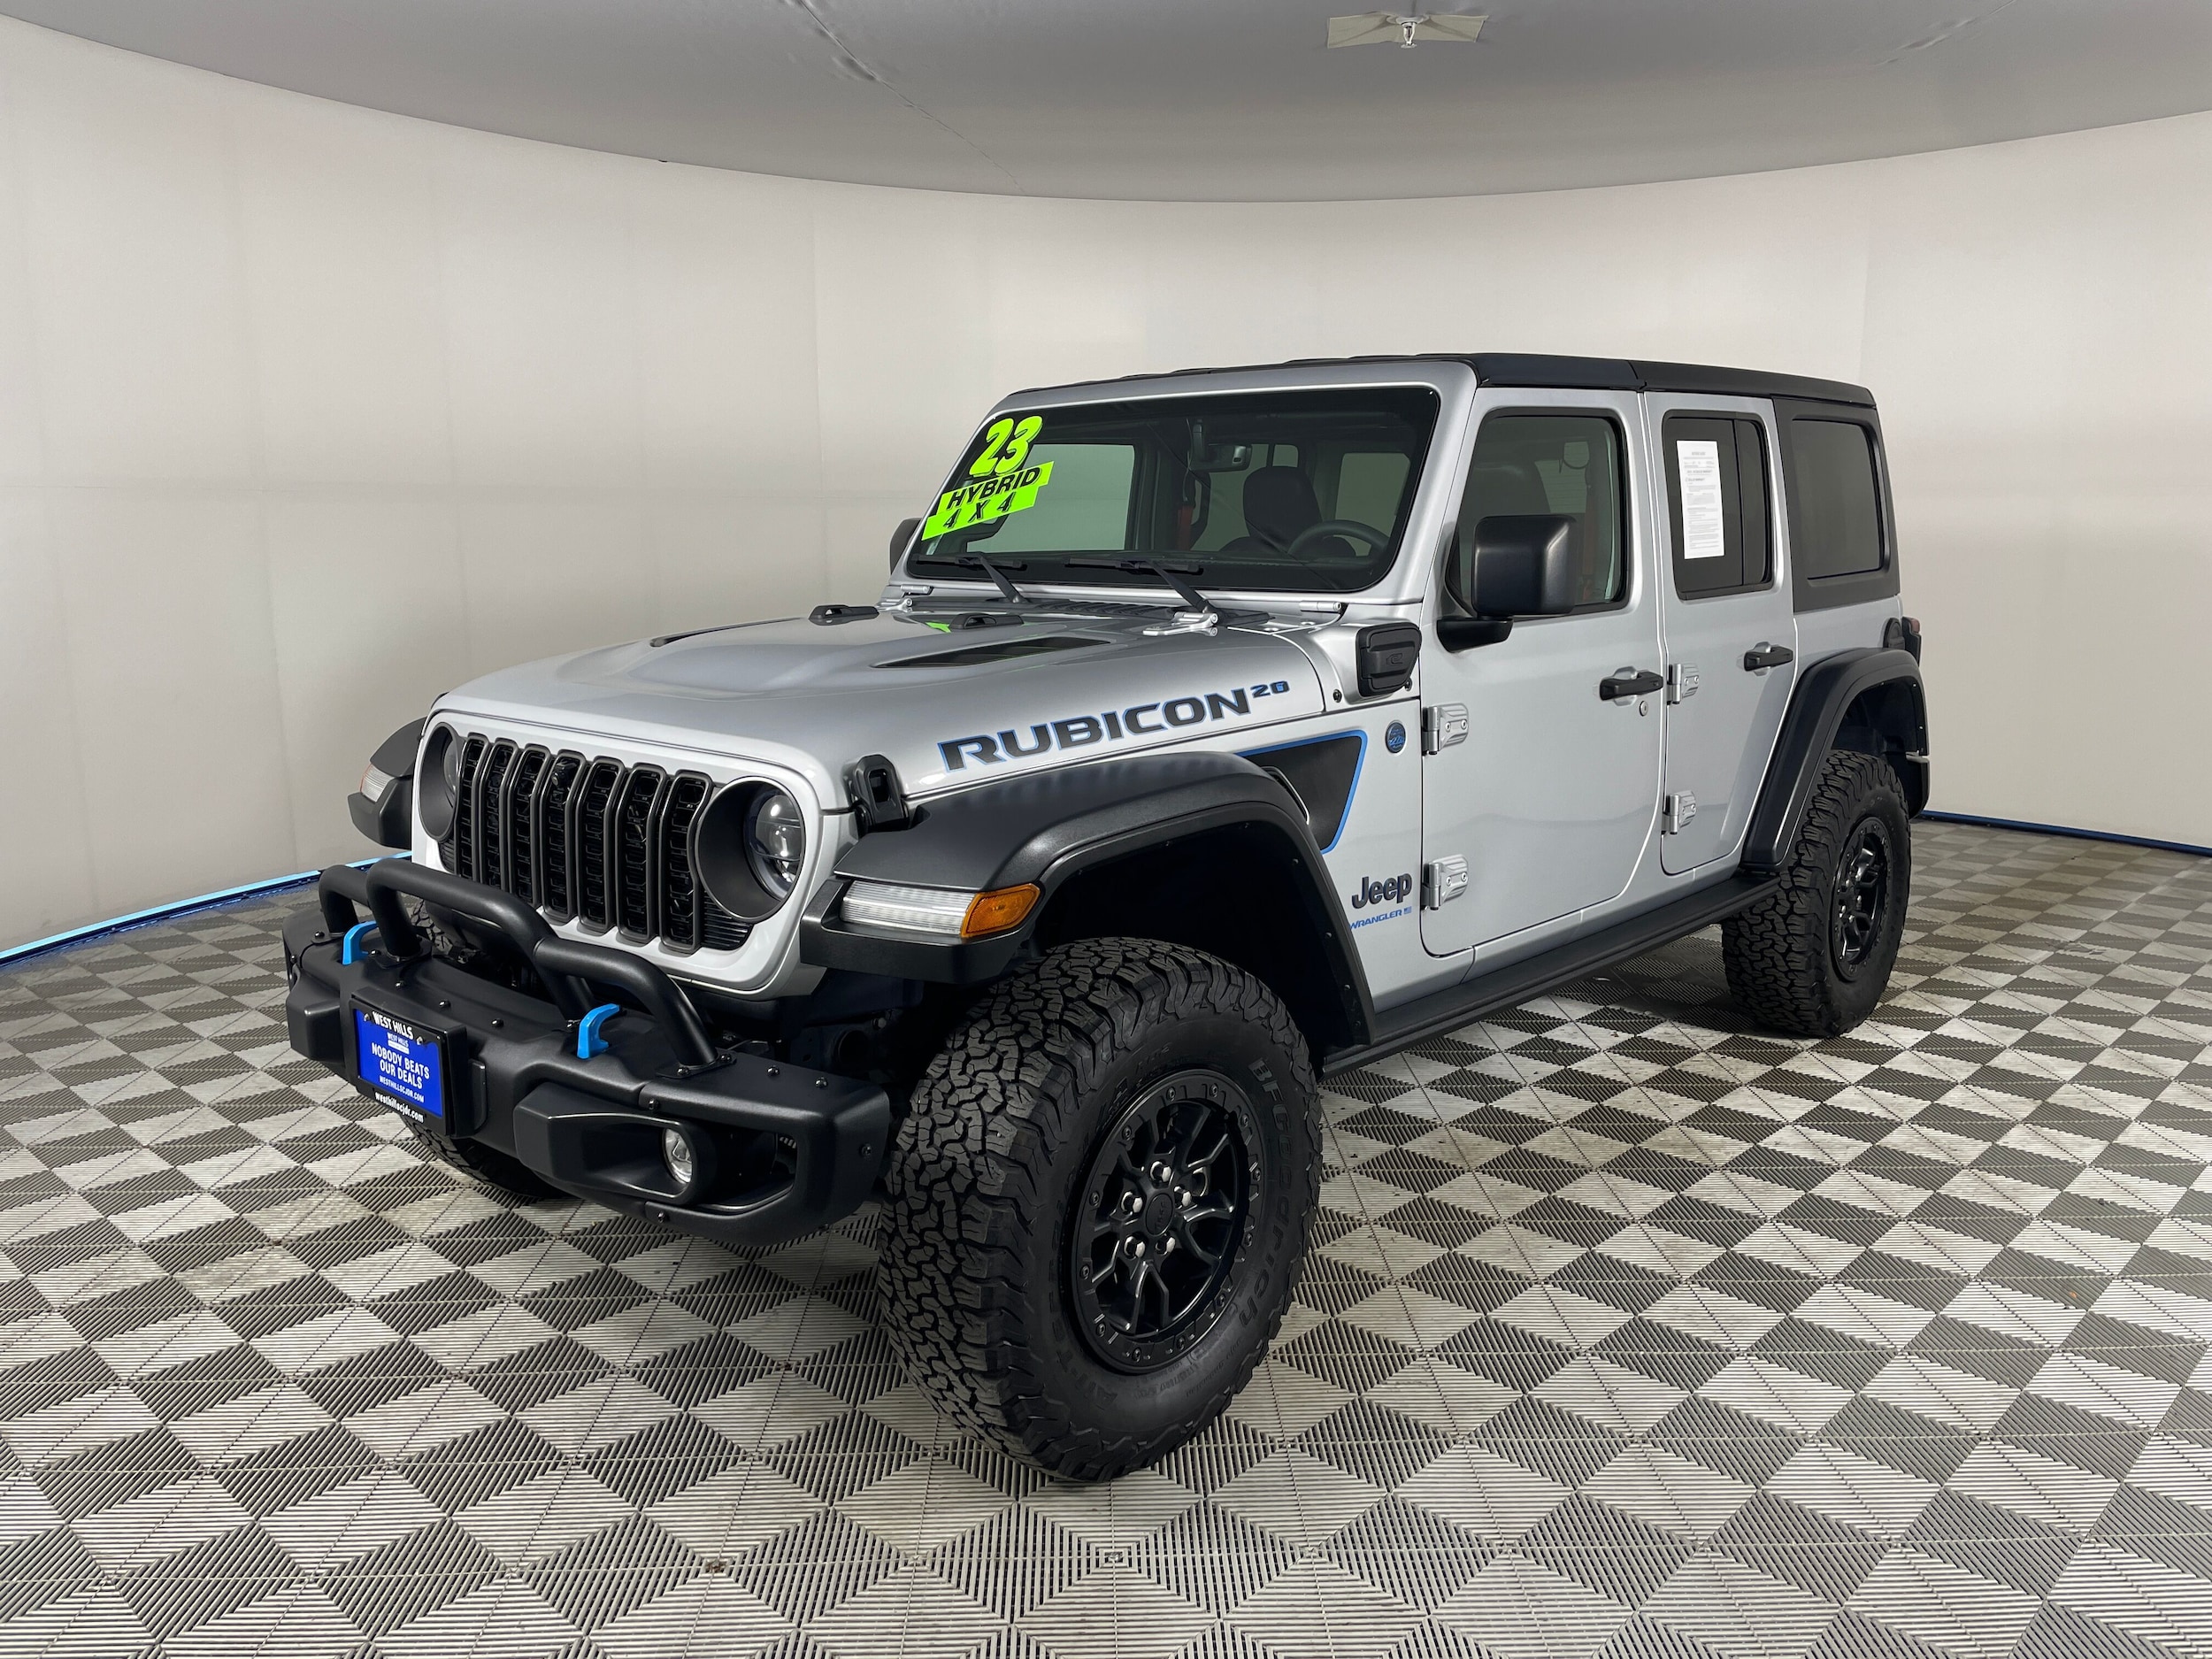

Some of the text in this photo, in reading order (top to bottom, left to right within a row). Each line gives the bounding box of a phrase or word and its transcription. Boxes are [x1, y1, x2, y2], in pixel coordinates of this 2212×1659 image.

[969, 416, 1042, 477] 23
[947, 467, 1041, 511] HYBRID
[943, 509, 961, 528] 4
[996, 492, 1017, 512] 4
[937, 687, 1251, 773] RUBICON
[1351, 873, 1412, 909] Jeep
[1349, 909, 1402, 930] WRANGLER
[373, 1010, 413, 1040] WEST HILLS
[372, 1042, 403, 1067] NOBODY
[404, 1056, 430, 1079] BEATS
[380, 1059, 423, 1090] OUR DEALS
